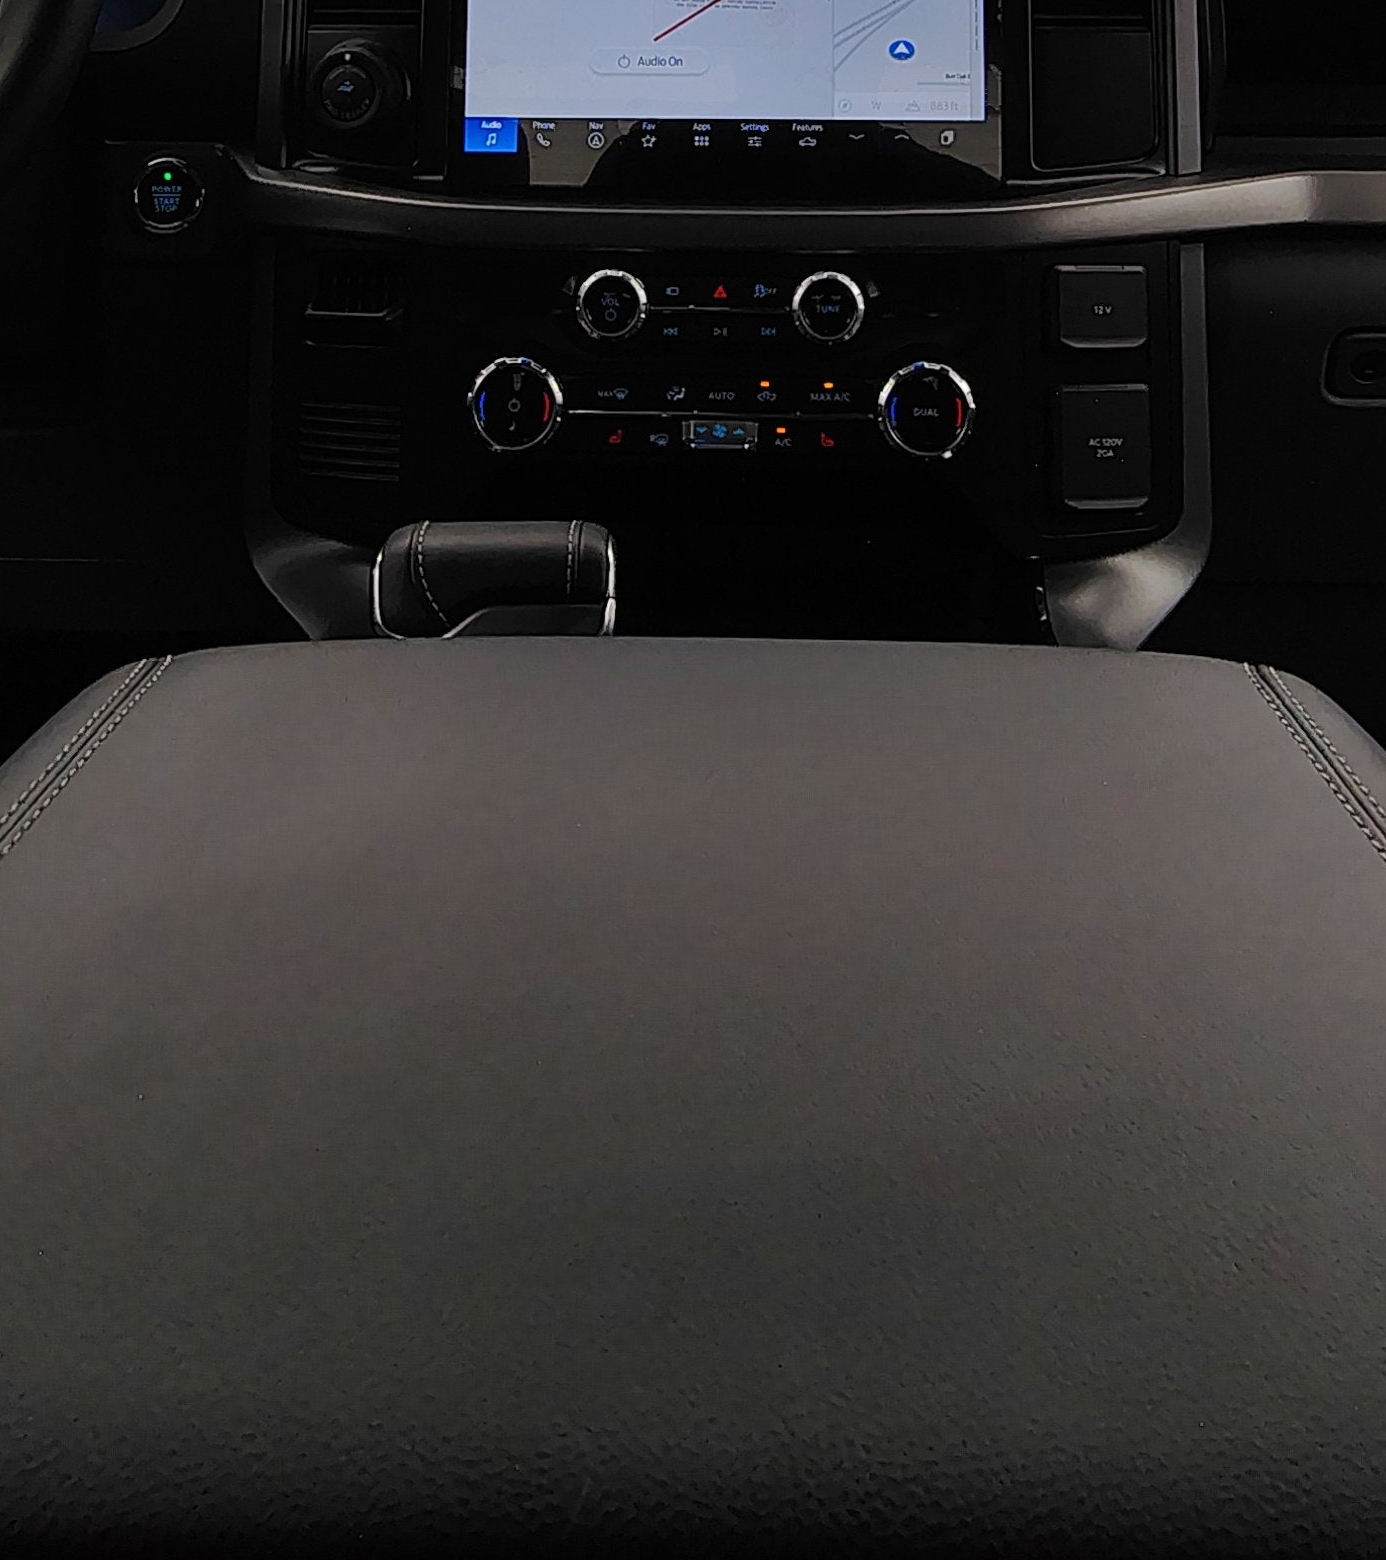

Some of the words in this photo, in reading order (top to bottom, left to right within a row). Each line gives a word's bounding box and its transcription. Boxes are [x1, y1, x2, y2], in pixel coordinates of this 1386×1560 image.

[637, 55, 667, 66] Audio
[668, 55, 683, 66] On
[481, 121, 502, 129] Audio
[532, 121, 556, 130] Phone
[589, 121, 604, 130] Nav
[642, 122, 656, 130] Fav
[692, 122, 711, 132] Apps
[740, 122, 770, 132] Settings
[792, 122, 824, 131] Features
[151, 185, 182, 193] POWER
[601, 298, 620, 307] VOL
[815, 304, 841, 313] TUNE
[708, 391, 735, 400] AUTO
[810, 392, 832, 402] MAX
[833, 392, 851, 402] A/C
[913, 407, 940, 417] DUAL
[775, 438, 791, 447] A/C
